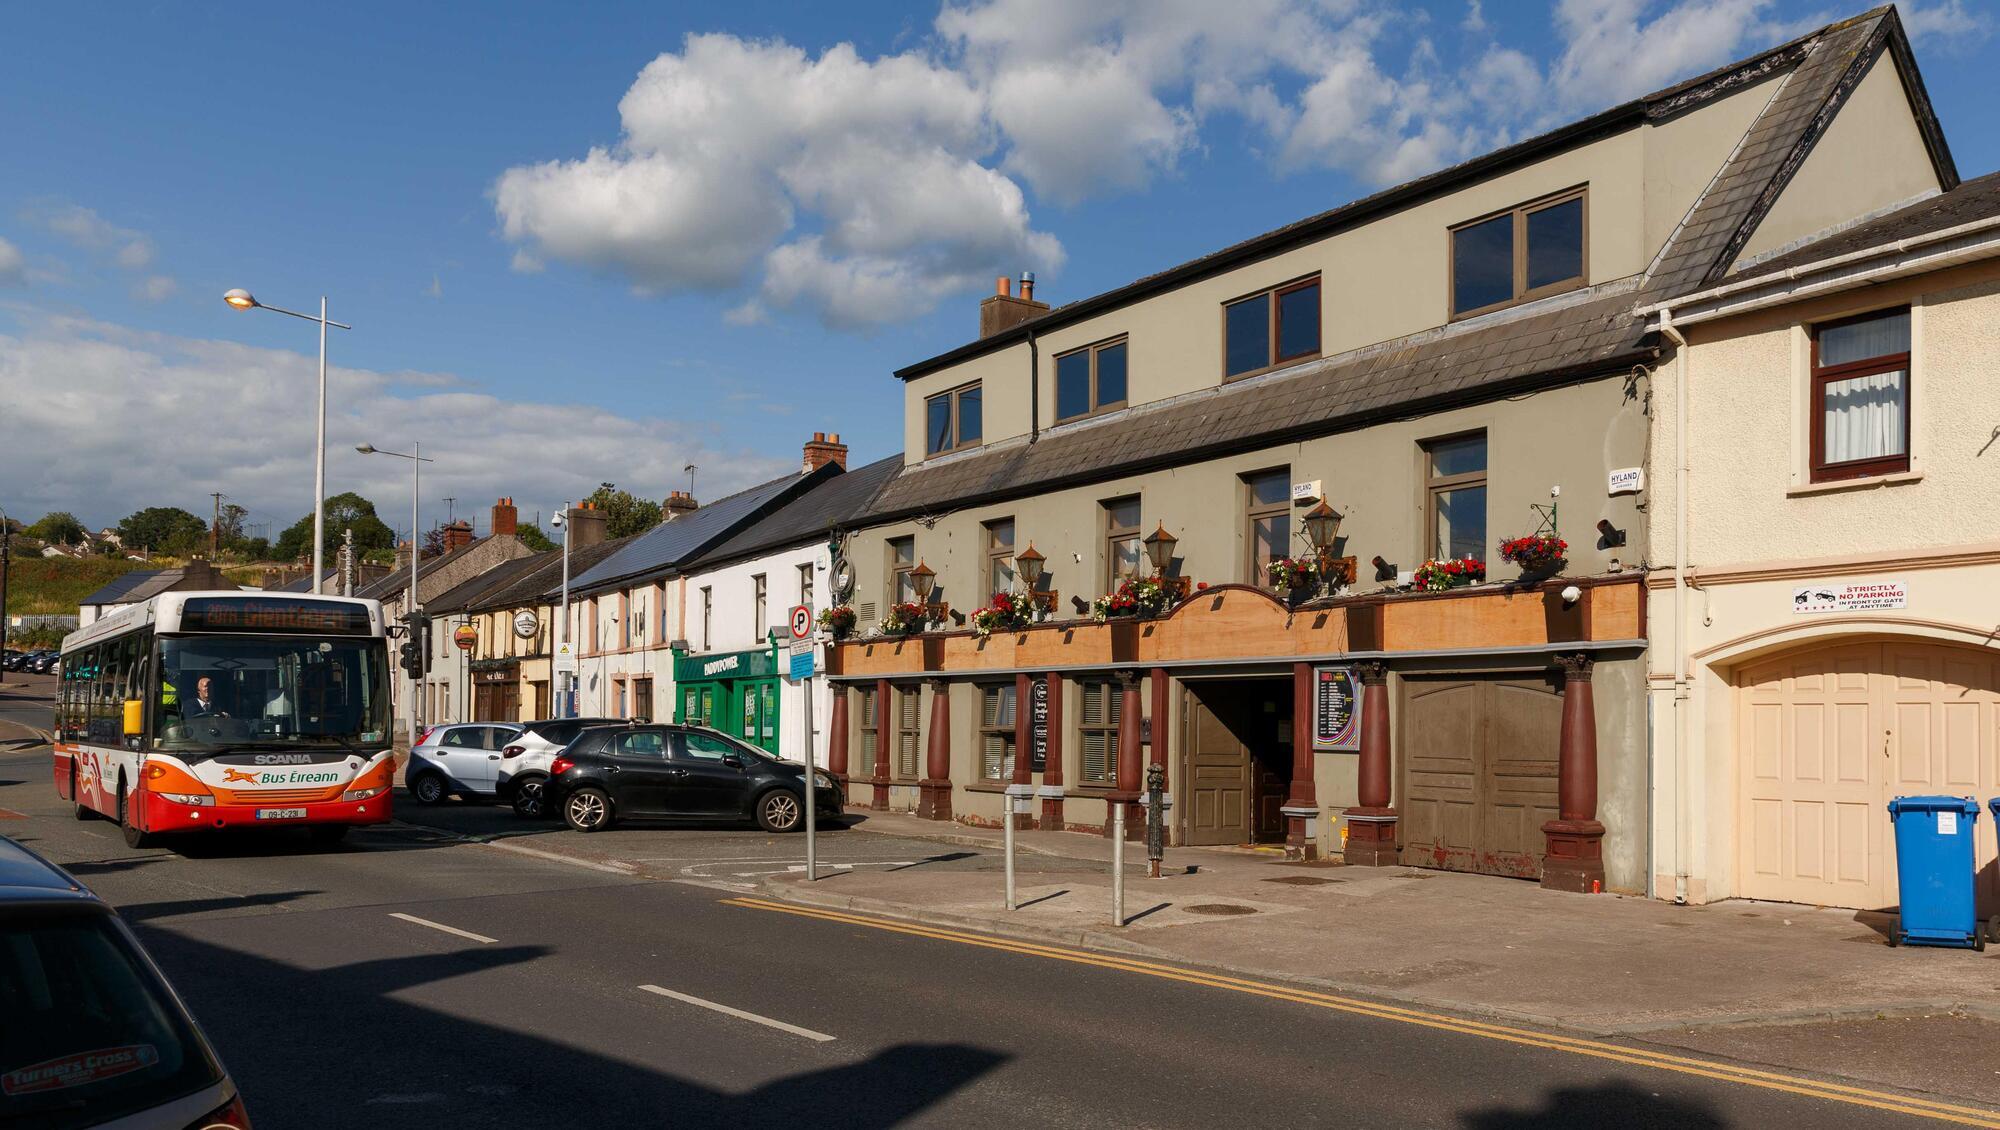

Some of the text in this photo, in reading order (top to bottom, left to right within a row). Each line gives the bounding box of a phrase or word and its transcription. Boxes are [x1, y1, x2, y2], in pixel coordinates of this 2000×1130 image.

[1611, 472, 1637, 482] HYLAND
[1846, 584, 1896, 593] STRICTLY
[1857, 591, 1904, 599] PARKING
[254, 754, 312, 765] SCANIA
[261, 773, 286, 784] Bus
[268, 810, 299, 819] 09-C-231
[12, 1060, 82, 1085] Turners
[86, 1051, 132, 1068] Cross
